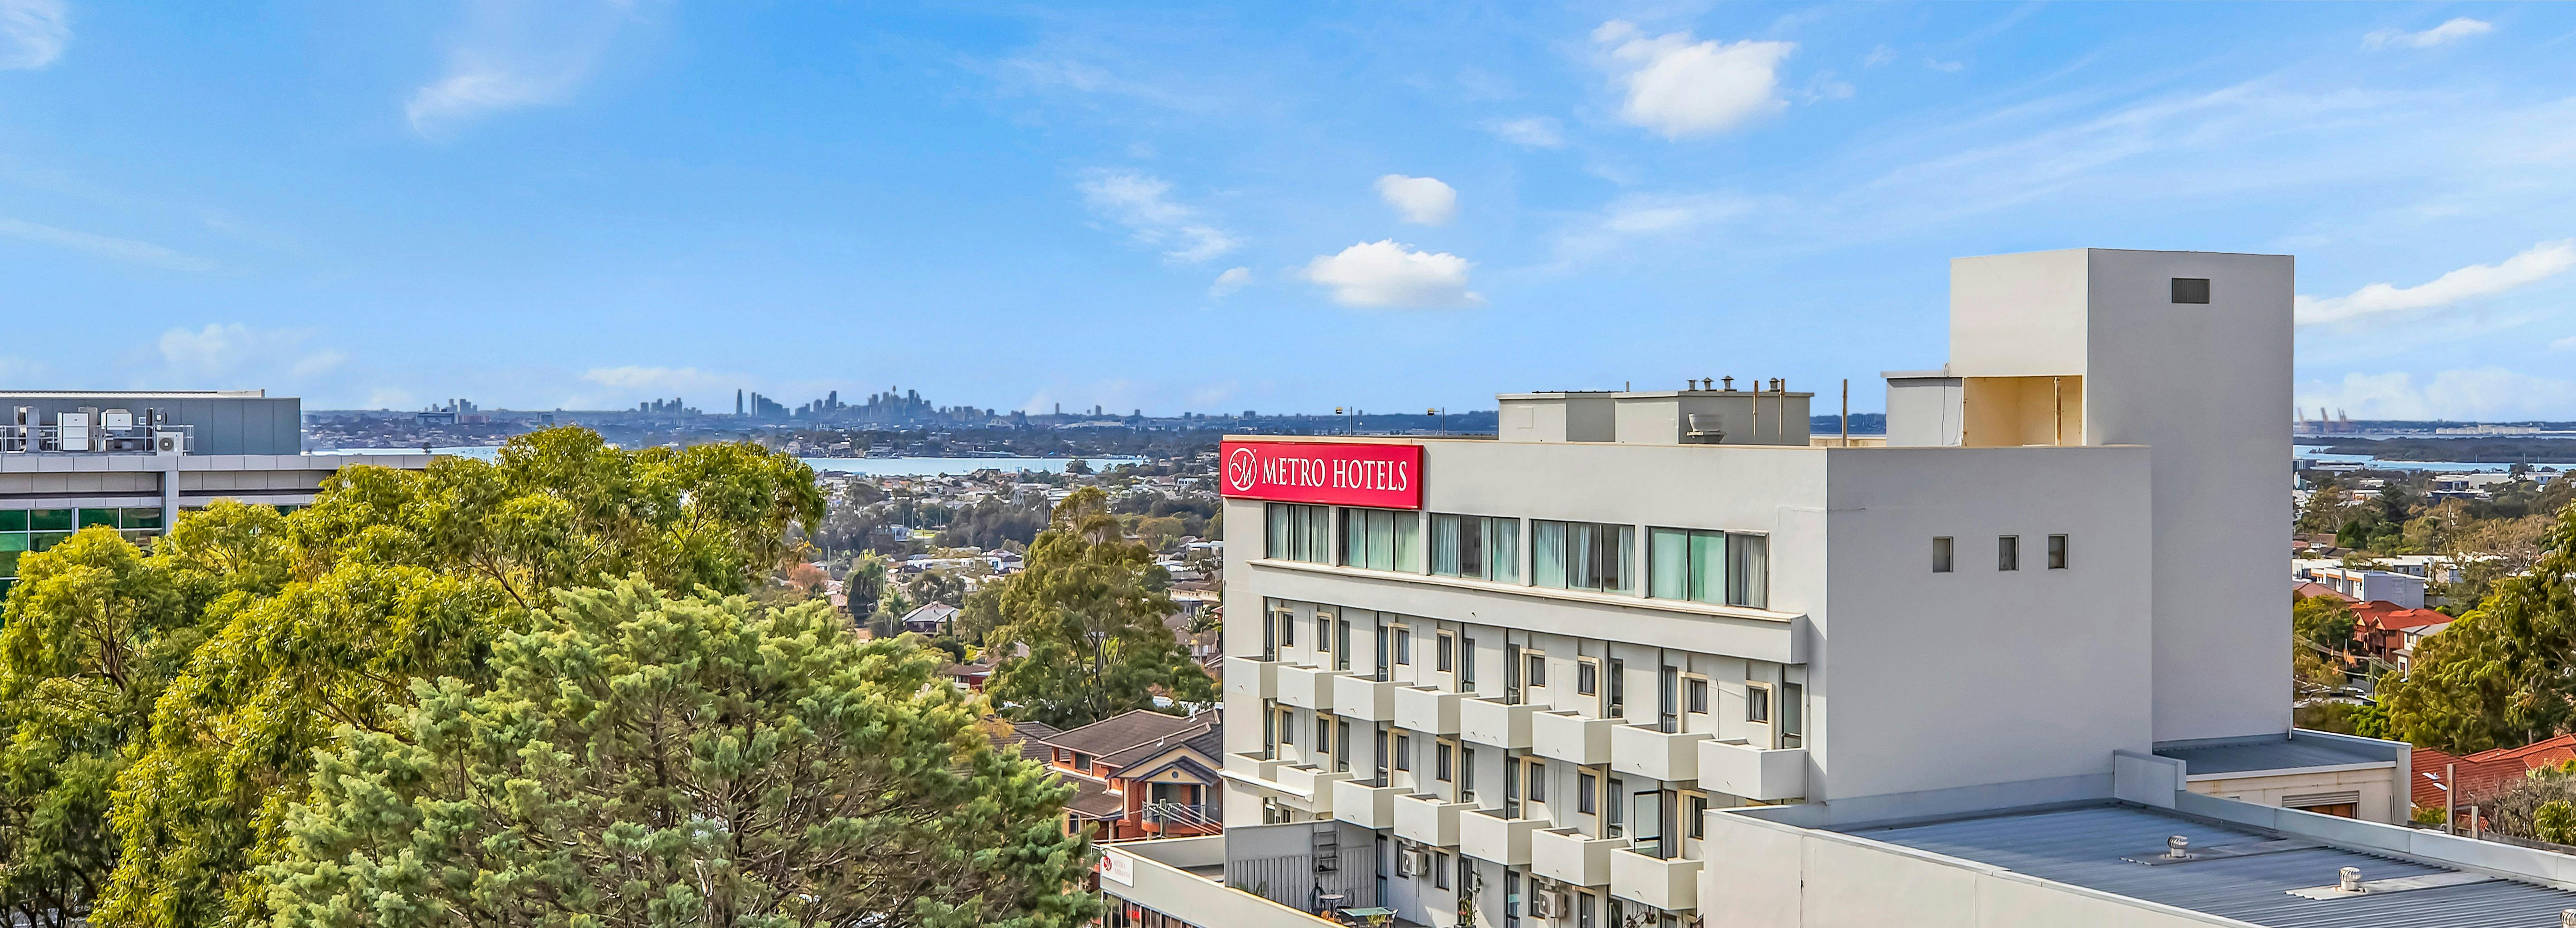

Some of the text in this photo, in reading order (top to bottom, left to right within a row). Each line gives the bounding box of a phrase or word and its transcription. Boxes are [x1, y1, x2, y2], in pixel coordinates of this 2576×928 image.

[1262, 456, 1407, 491] METRO HOTELS
[1113, 859, 1125, 869] METRO
